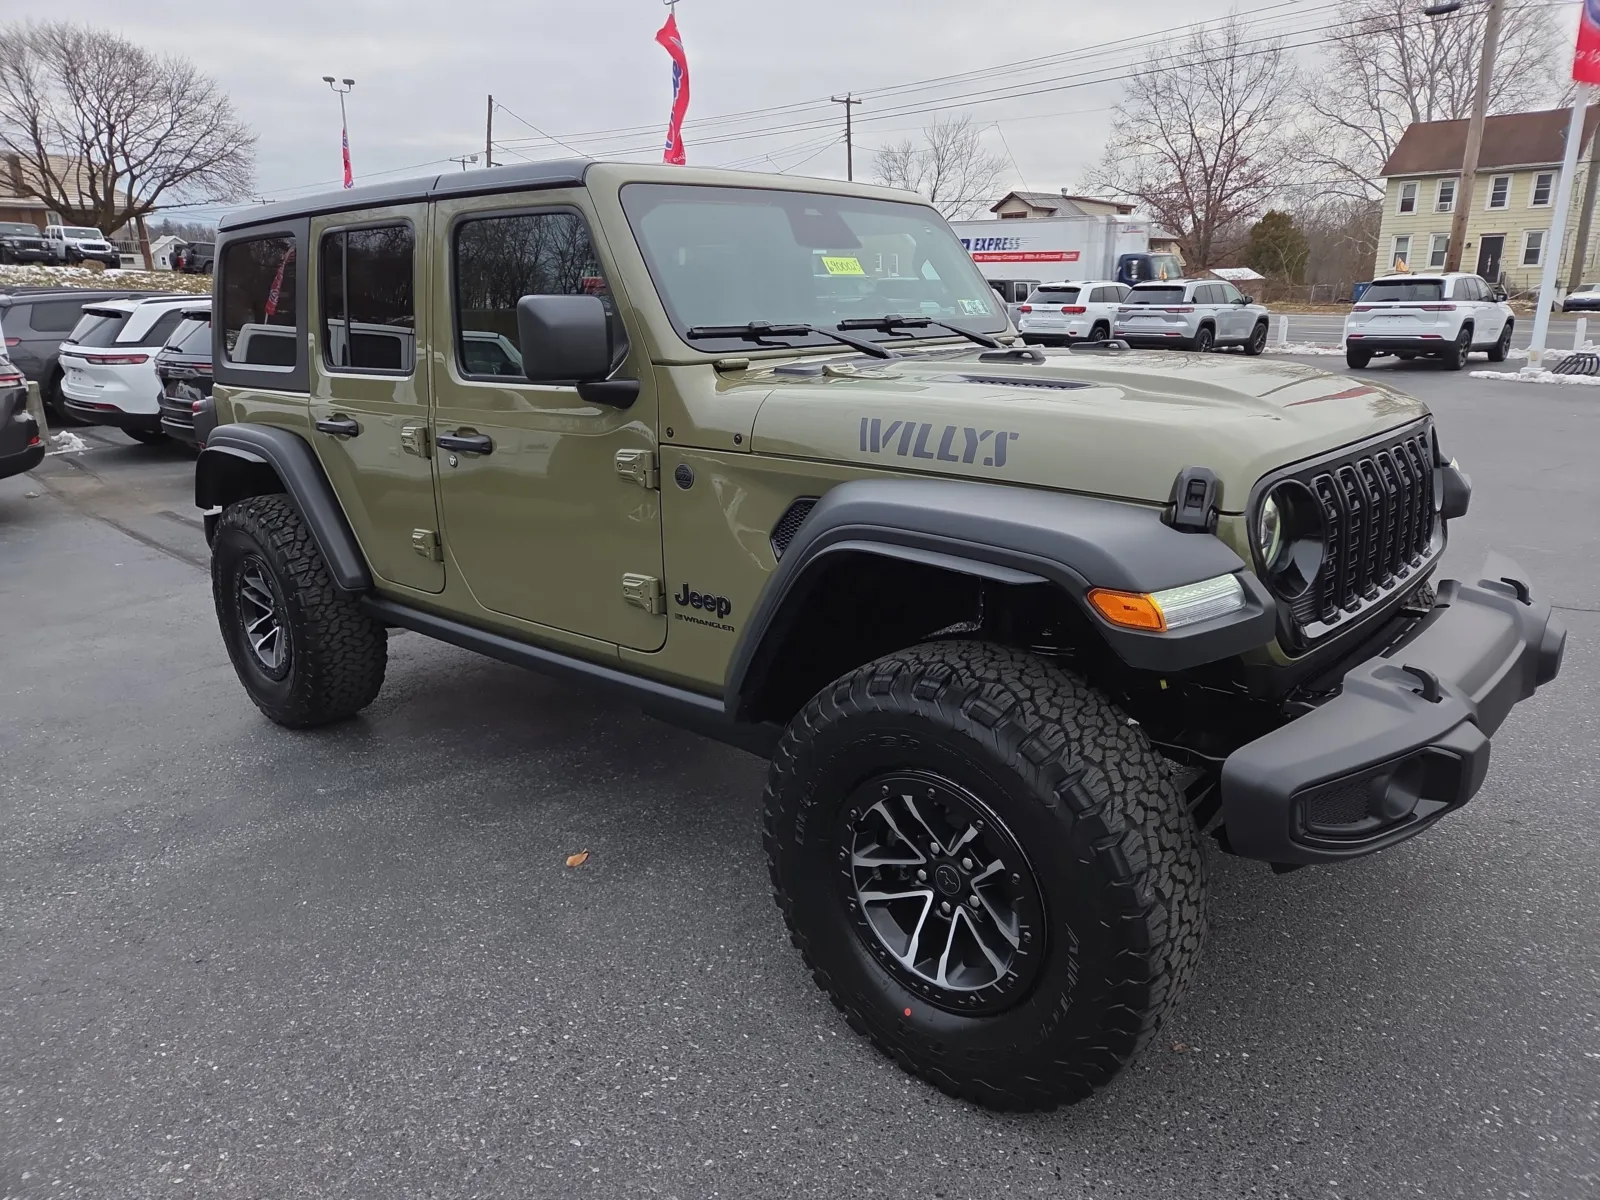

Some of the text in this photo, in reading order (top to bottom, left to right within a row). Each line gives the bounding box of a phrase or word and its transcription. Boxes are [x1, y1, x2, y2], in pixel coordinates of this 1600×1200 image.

[973, 237, 1021, 251] EXPRESS
[859, 417, 1020, 467] WILLYS
[674, 582, 732, 619] Jeep
[683, 614, 735, 632] WRANGLER
